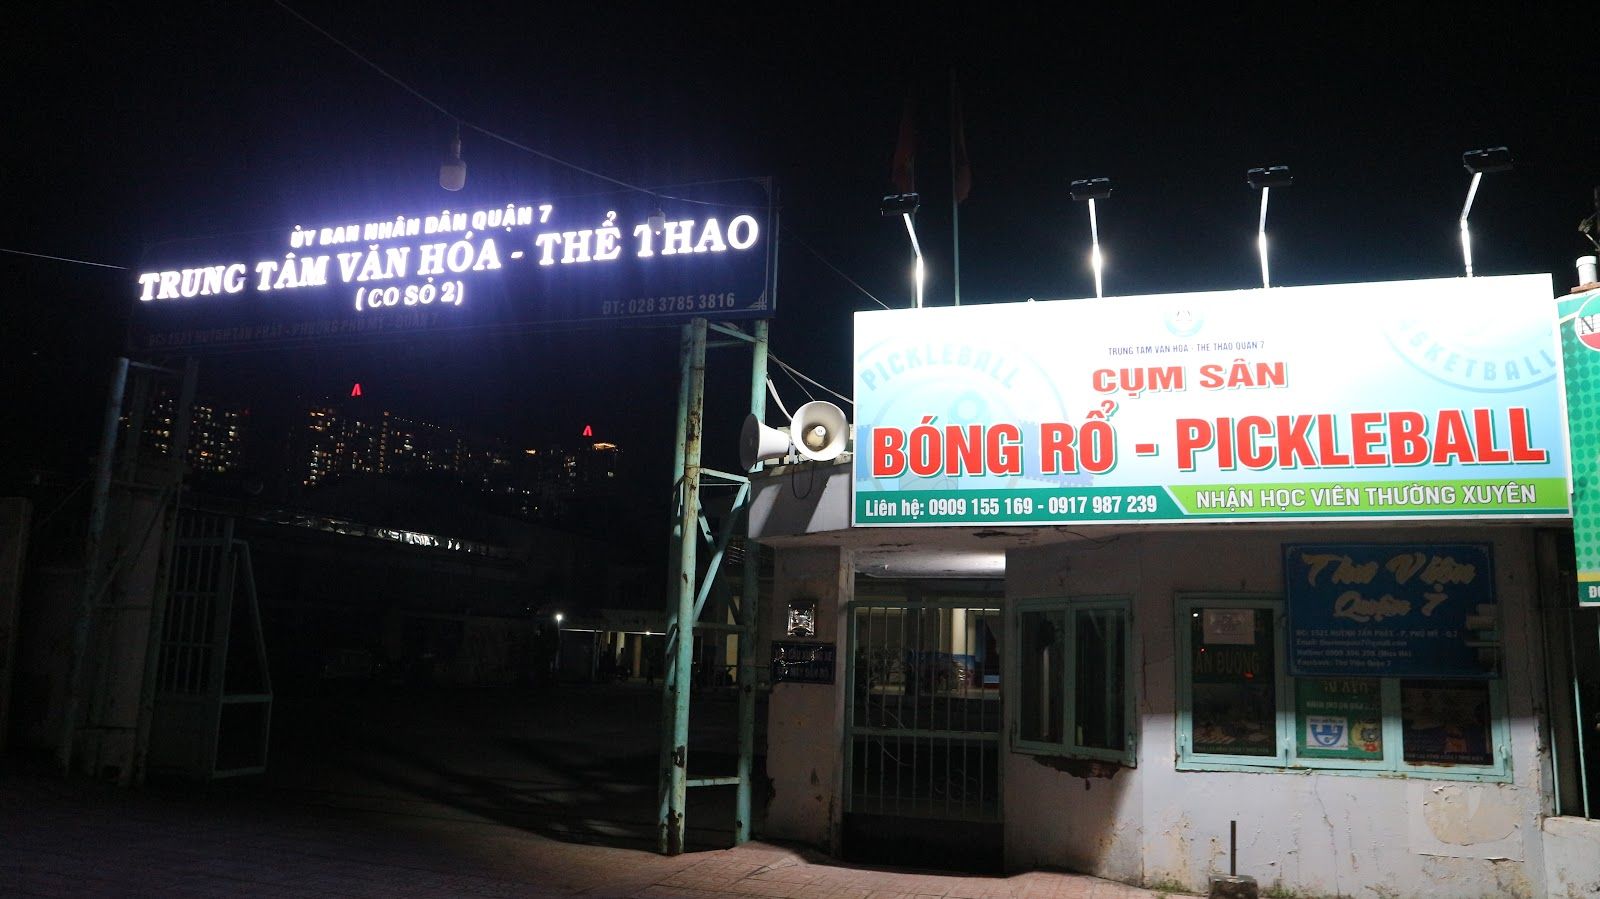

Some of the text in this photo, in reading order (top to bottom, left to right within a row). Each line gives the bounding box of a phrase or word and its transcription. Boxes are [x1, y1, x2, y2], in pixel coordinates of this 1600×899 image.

[319, 225, 360, 246] BAN
[363, 215, 420, 242] NHÂN
[424, 209, 467, 236] DÂN
[472, 203, 533, 232] QUẬN
[538, 204, 553, 224] 7
[137, 263, 247, 302] TRUNG
[255, 252, 330, 291] TÂM
[337, 243, 410, 283] VĂN
[417, 230, 502, 276] HÓA
[535, 210, 622, 266] THỂ
[633, 214, 760, 258] THAO
[628, 298, 654, 313] 028
[658, 295, 694, 312] 3785
[698, 292, 736, 309] 3816
[859, 343, 1021, 392] PICKLEBALL
[1108, 346, 1134, 356] TRUNG
[1260, 340, 1266, 349] 7
[1092, 358, 1289, 398] CỤM SÂN
[872, 415, 1024, 479] BÓNG
[1040, 399, 1119, 475] RỔ
[1176, 406, 1550, 472] PICKLEBALL
[864, 498, 897, 518] Liên
[901, 498, 925, 519] hệ:
[928, 497, 968, 515] 0909
[971, 497, 1000, 514] 155
[1004, 496, 1033, 514] 169
[1048, 496, 1087, 514] 0917
[1092, 495, 1121, 514] 987
[1126, 494, 1157, 513] 239
[1195, 481, 1537, 512] NHẬN HỌC VIÊN THƯỜNG XUYÊN
